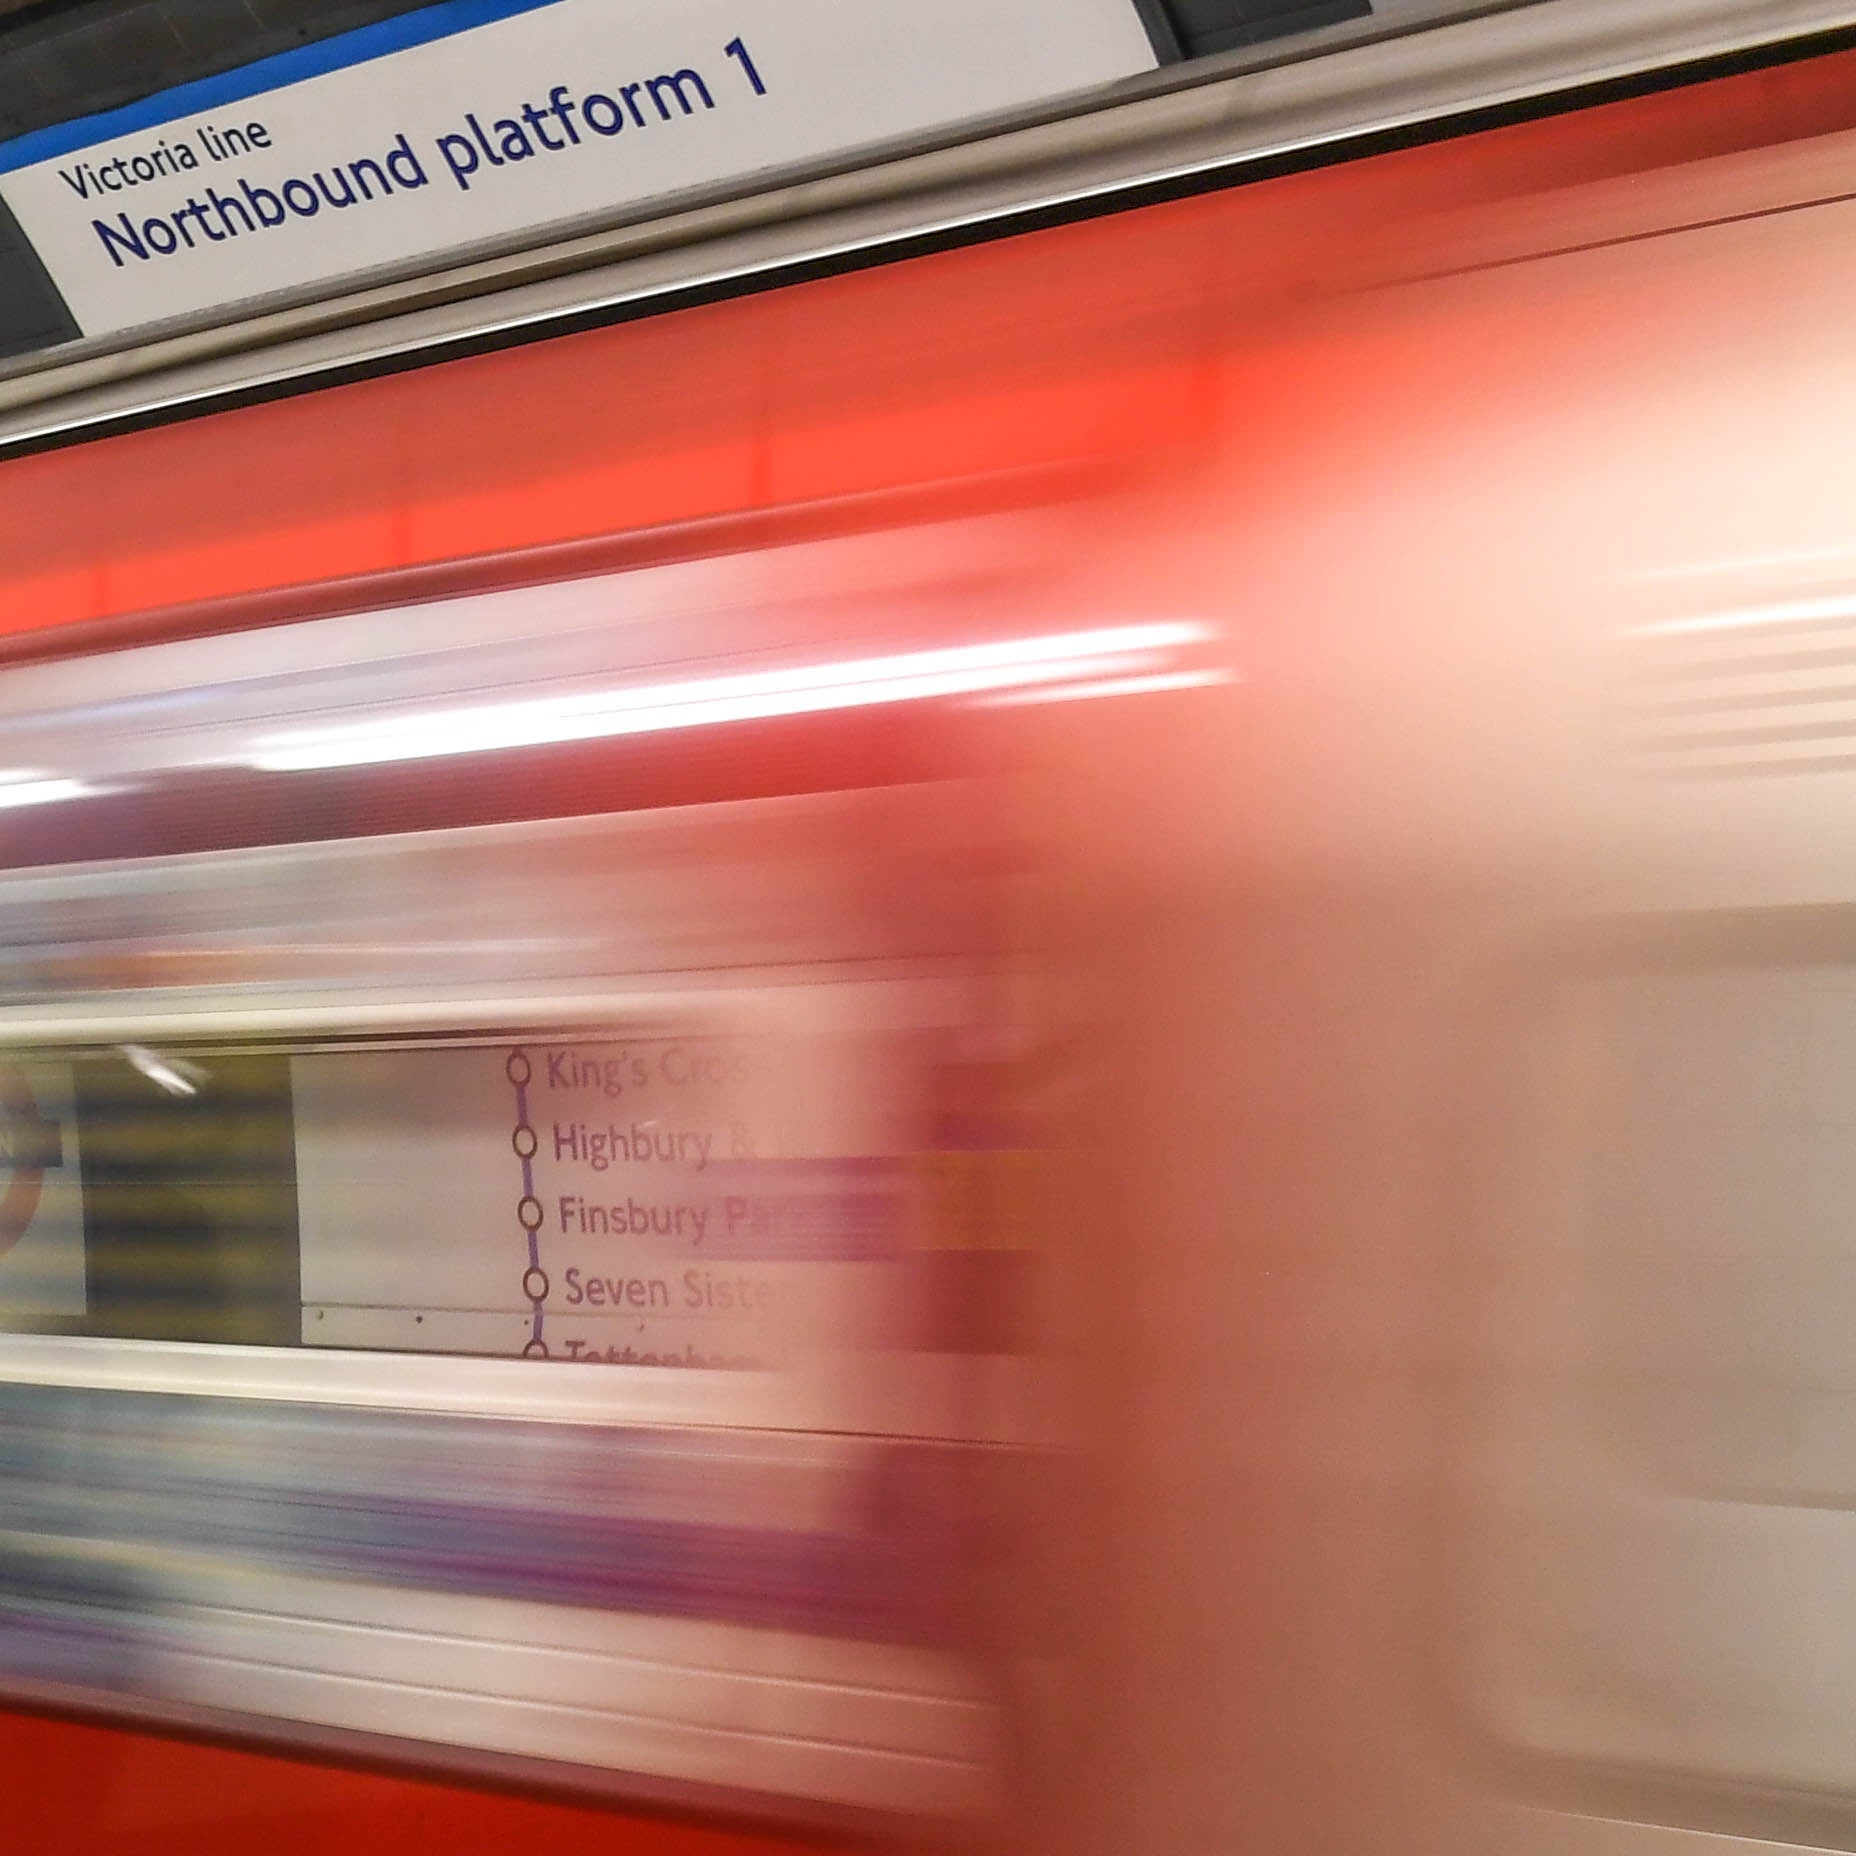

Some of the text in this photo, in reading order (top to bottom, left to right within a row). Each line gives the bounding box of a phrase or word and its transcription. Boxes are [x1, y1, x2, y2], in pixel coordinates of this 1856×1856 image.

[58, 120, 273, 200] Victoria line
[91, 36, 767, 268] Northbound platform 1
[546, 1050, 650, 1098] King's
[552, 1122, 713, 1172] Highbury
[558, 1196, 709, 1246] Finsbury
[564, 1267, 670, 1308] Seven
